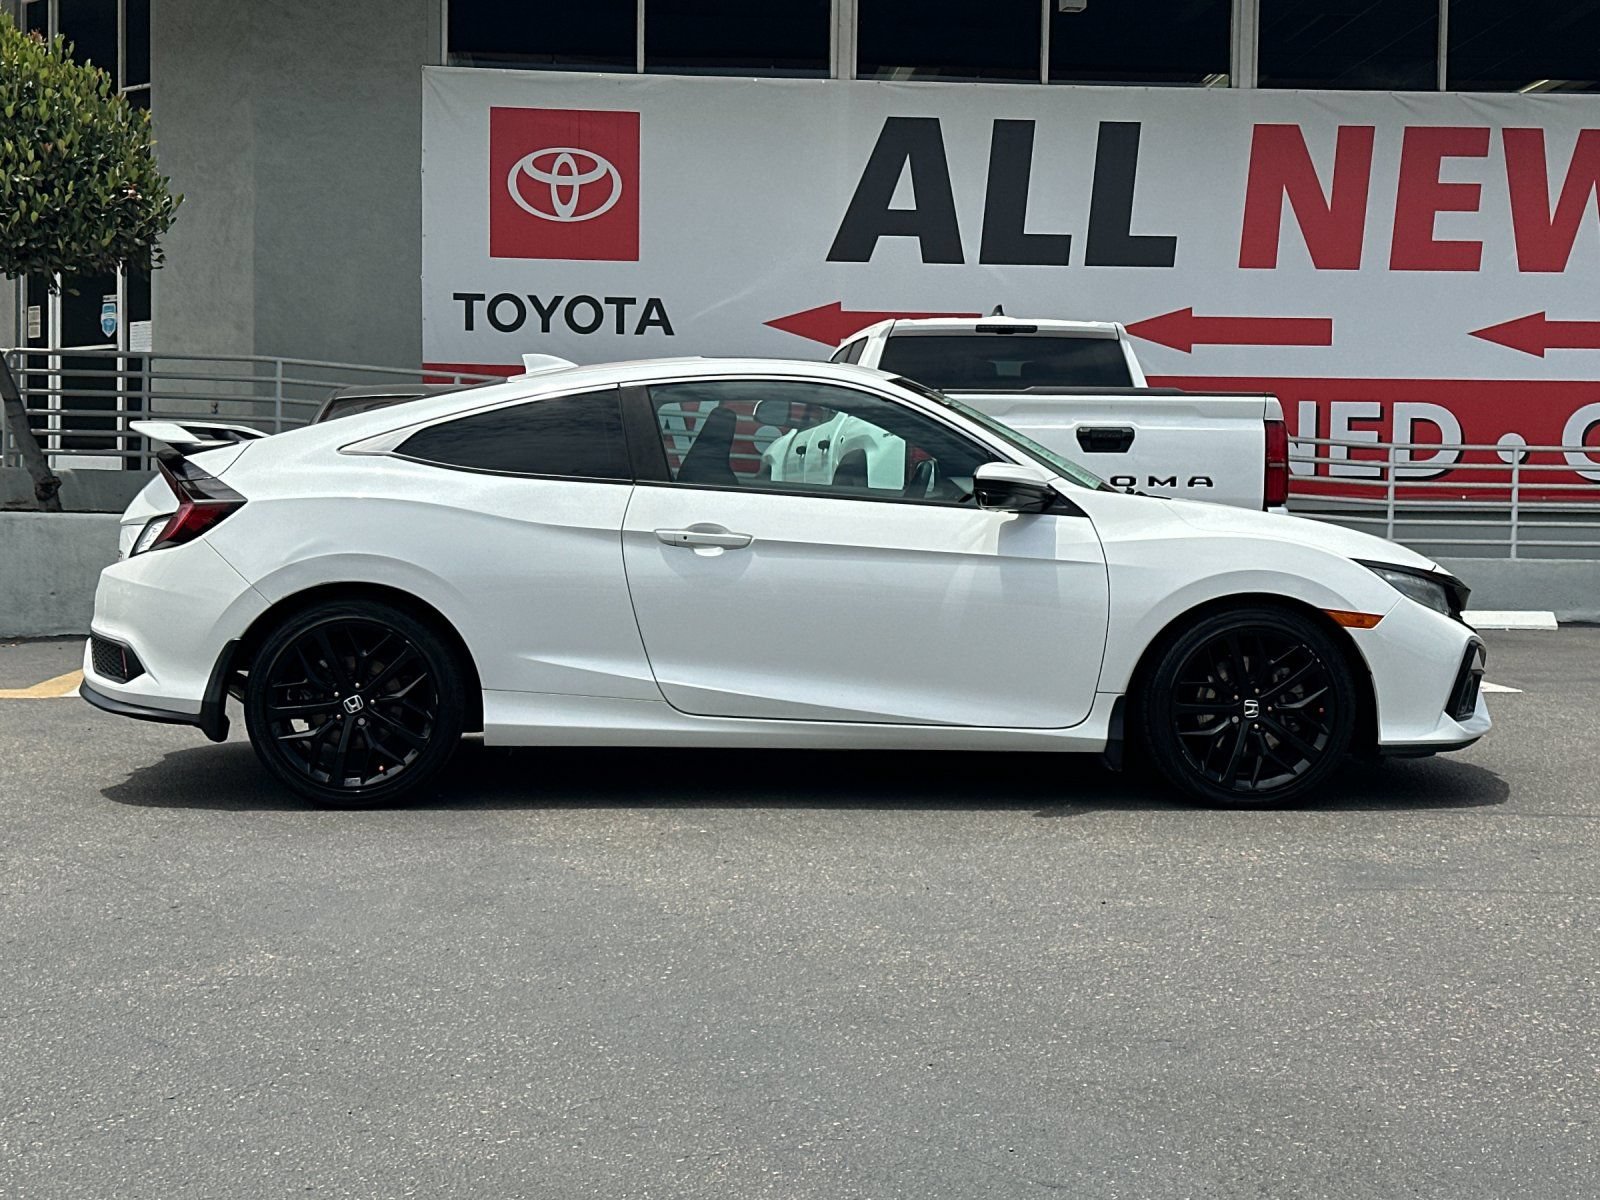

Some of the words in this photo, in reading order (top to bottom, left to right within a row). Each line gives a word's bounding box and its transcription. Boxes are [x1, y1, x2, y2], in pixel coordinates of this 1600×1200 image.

[825, 116, 1177, 268] ALL
[1238, 123, 1600, 273] NEW
[452, 292, 675, 336] TOYOTA
